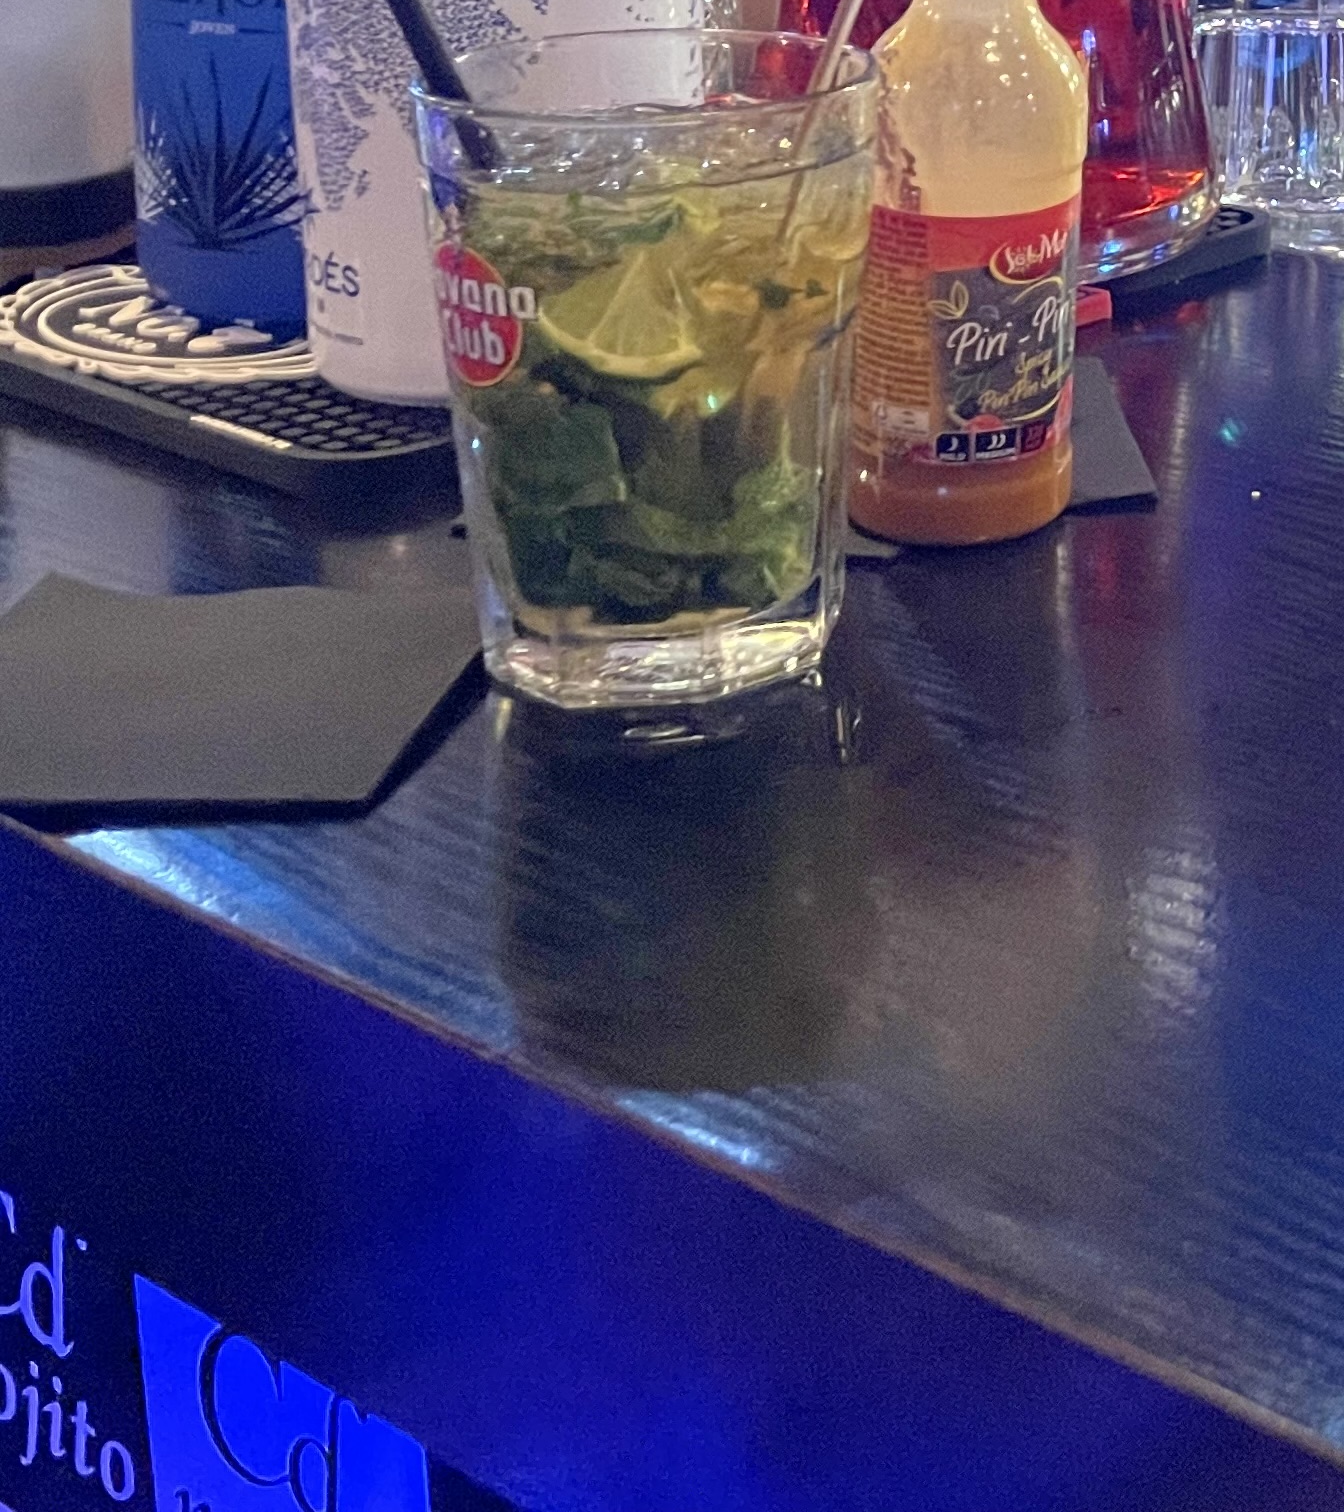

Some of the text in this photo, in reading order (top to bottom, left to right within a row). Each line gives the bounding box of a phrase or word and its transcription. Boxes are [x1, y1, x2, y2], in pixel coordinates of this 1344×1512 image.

[310, 251, 362, 298] DÉS
[946, 321, 1013, 366] Piri
[0, 1360, 136, 1501] ojito
